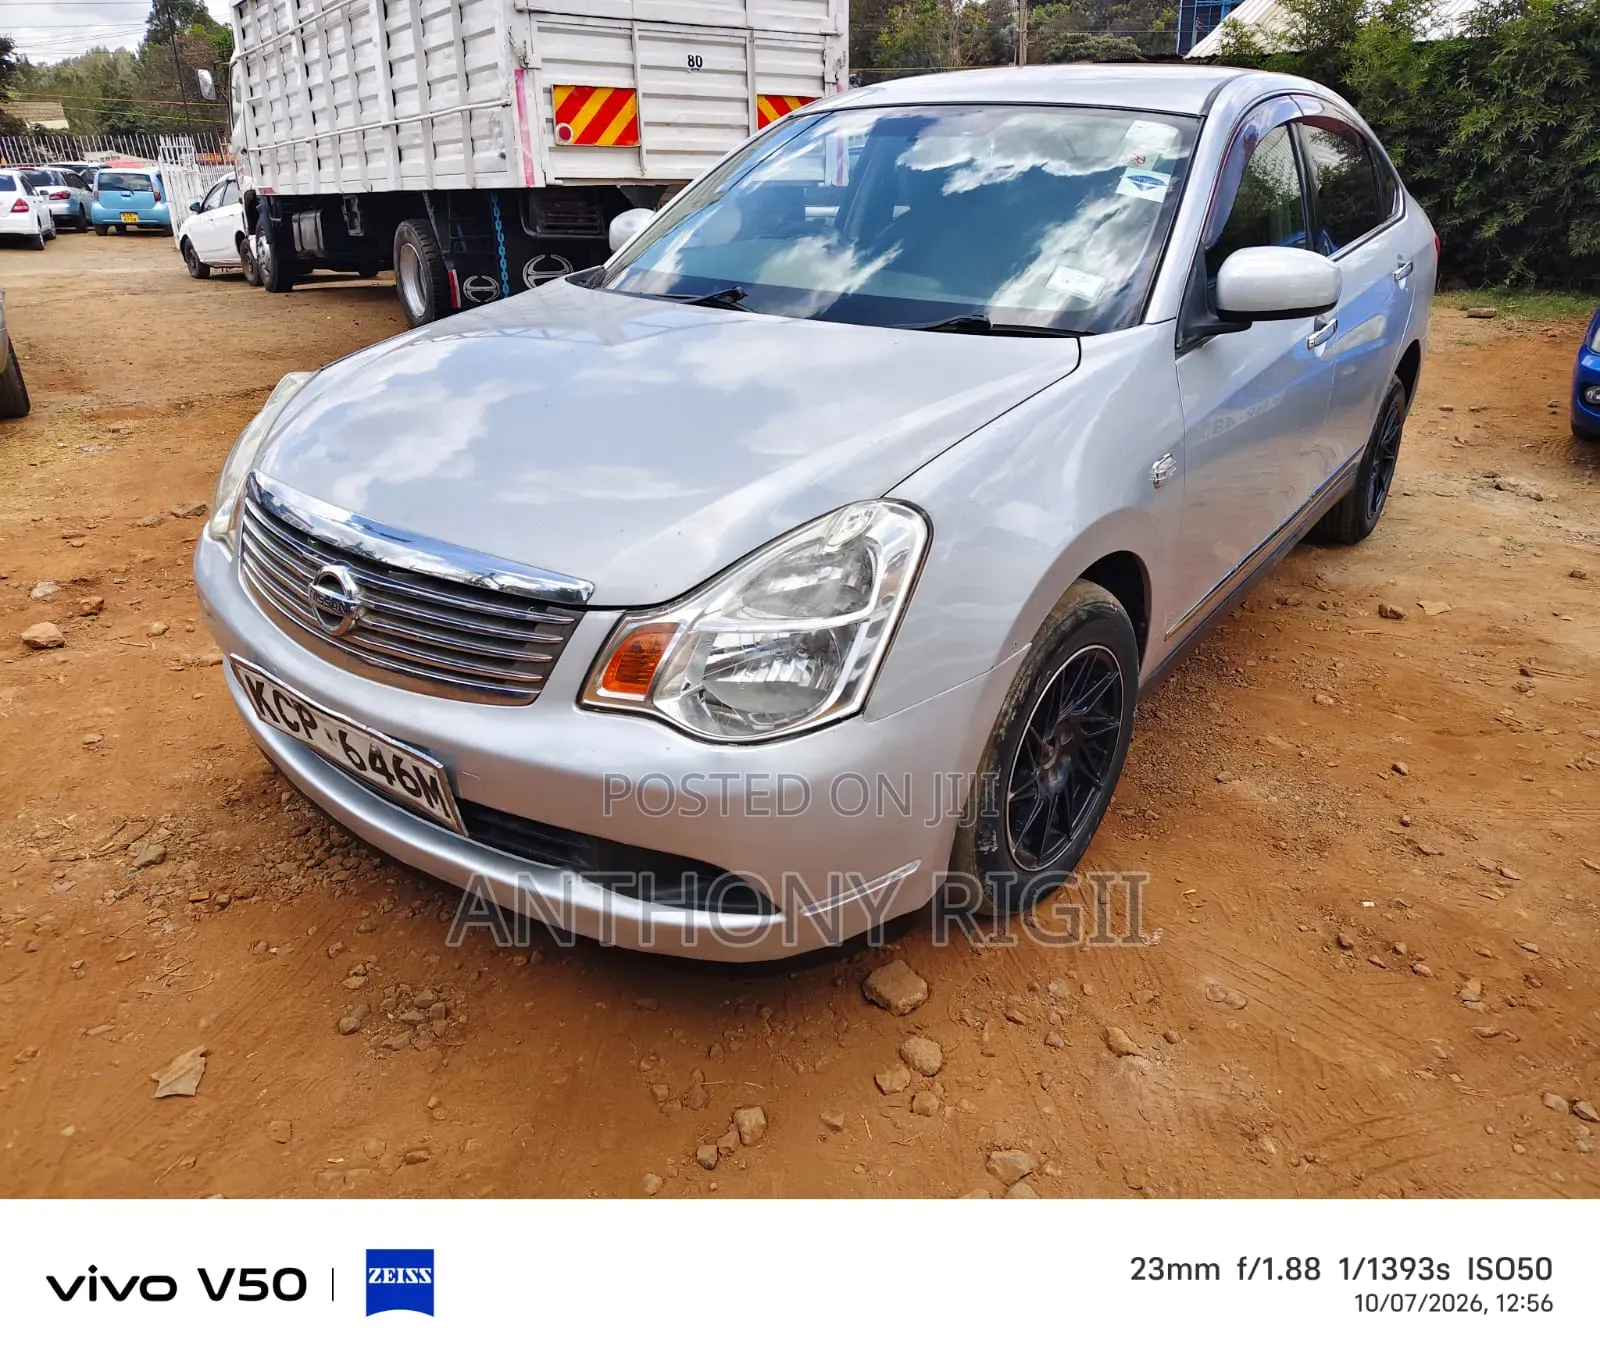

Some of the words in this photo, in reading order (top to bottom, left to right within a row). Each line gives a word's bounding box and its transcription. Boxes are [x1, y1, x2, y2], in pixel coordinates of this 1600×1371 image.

[687, 54, 703, 68] 80
[310, 589, 351, 614] NISSAN
[245, 675, 318, 740] KCP
[338, 729, 452, 819] 646M
